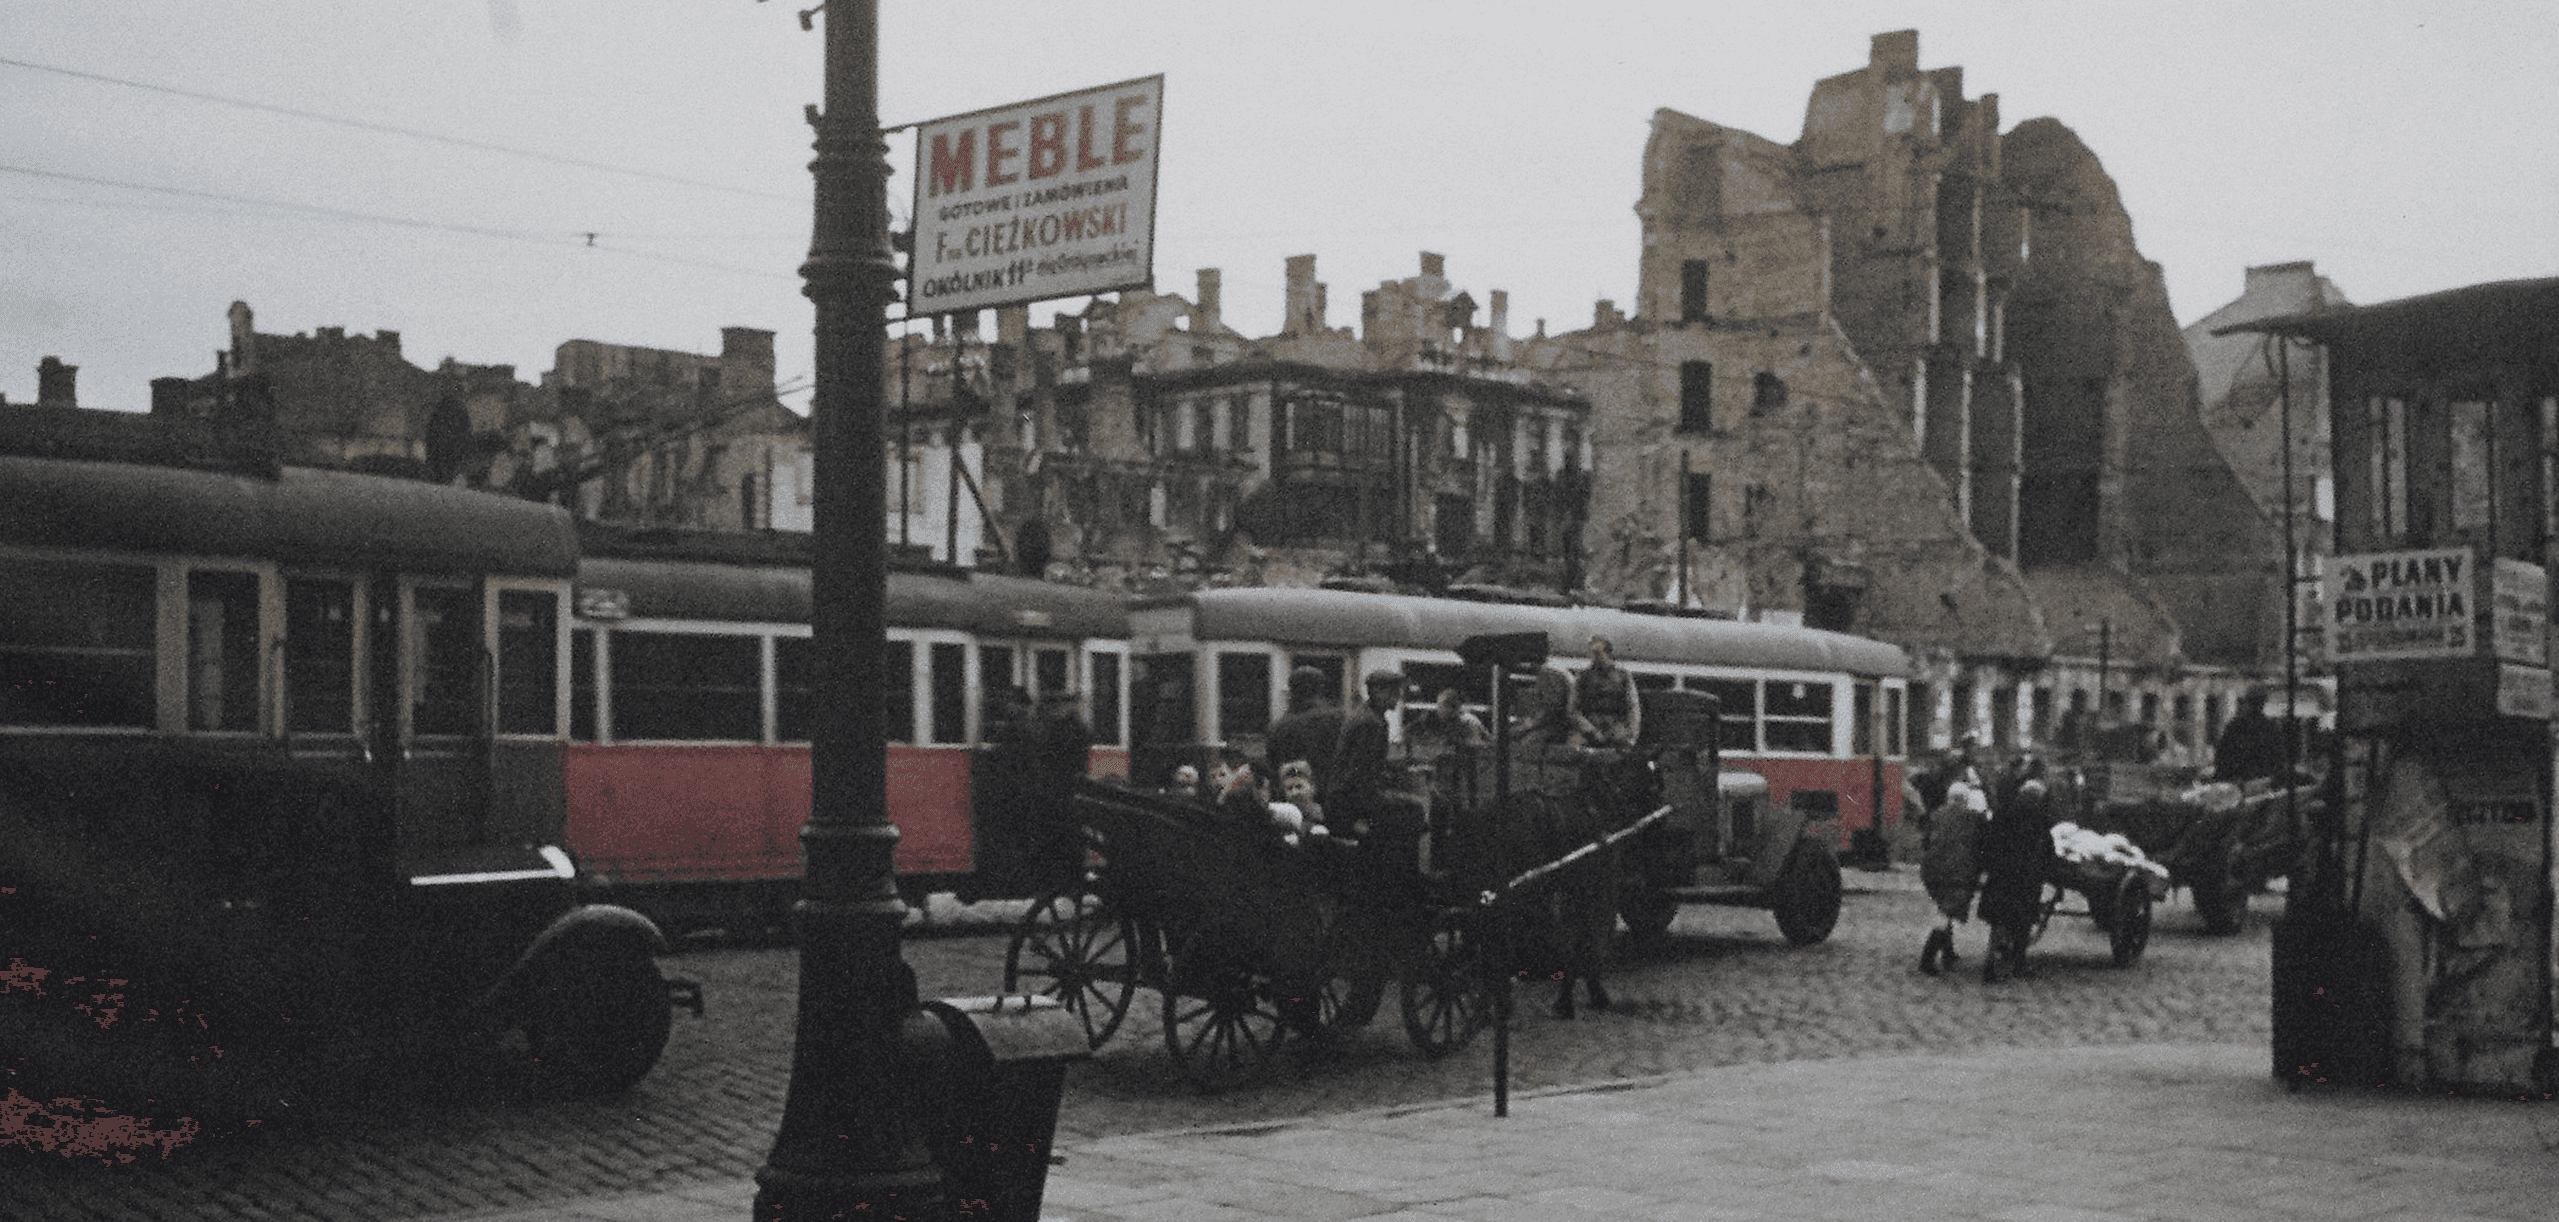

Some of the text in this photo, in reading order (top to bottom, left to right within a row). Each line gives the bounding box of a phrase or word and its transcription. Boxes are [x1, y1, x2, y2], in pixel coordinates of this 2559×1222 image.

[928, 94, 1148, 199] MEBLE
[939, 195, 1010, 222] GOTOWE
[2370, 554, 2464, 589] PLANY
[2336, 592, 2465, 622] PODANIA
